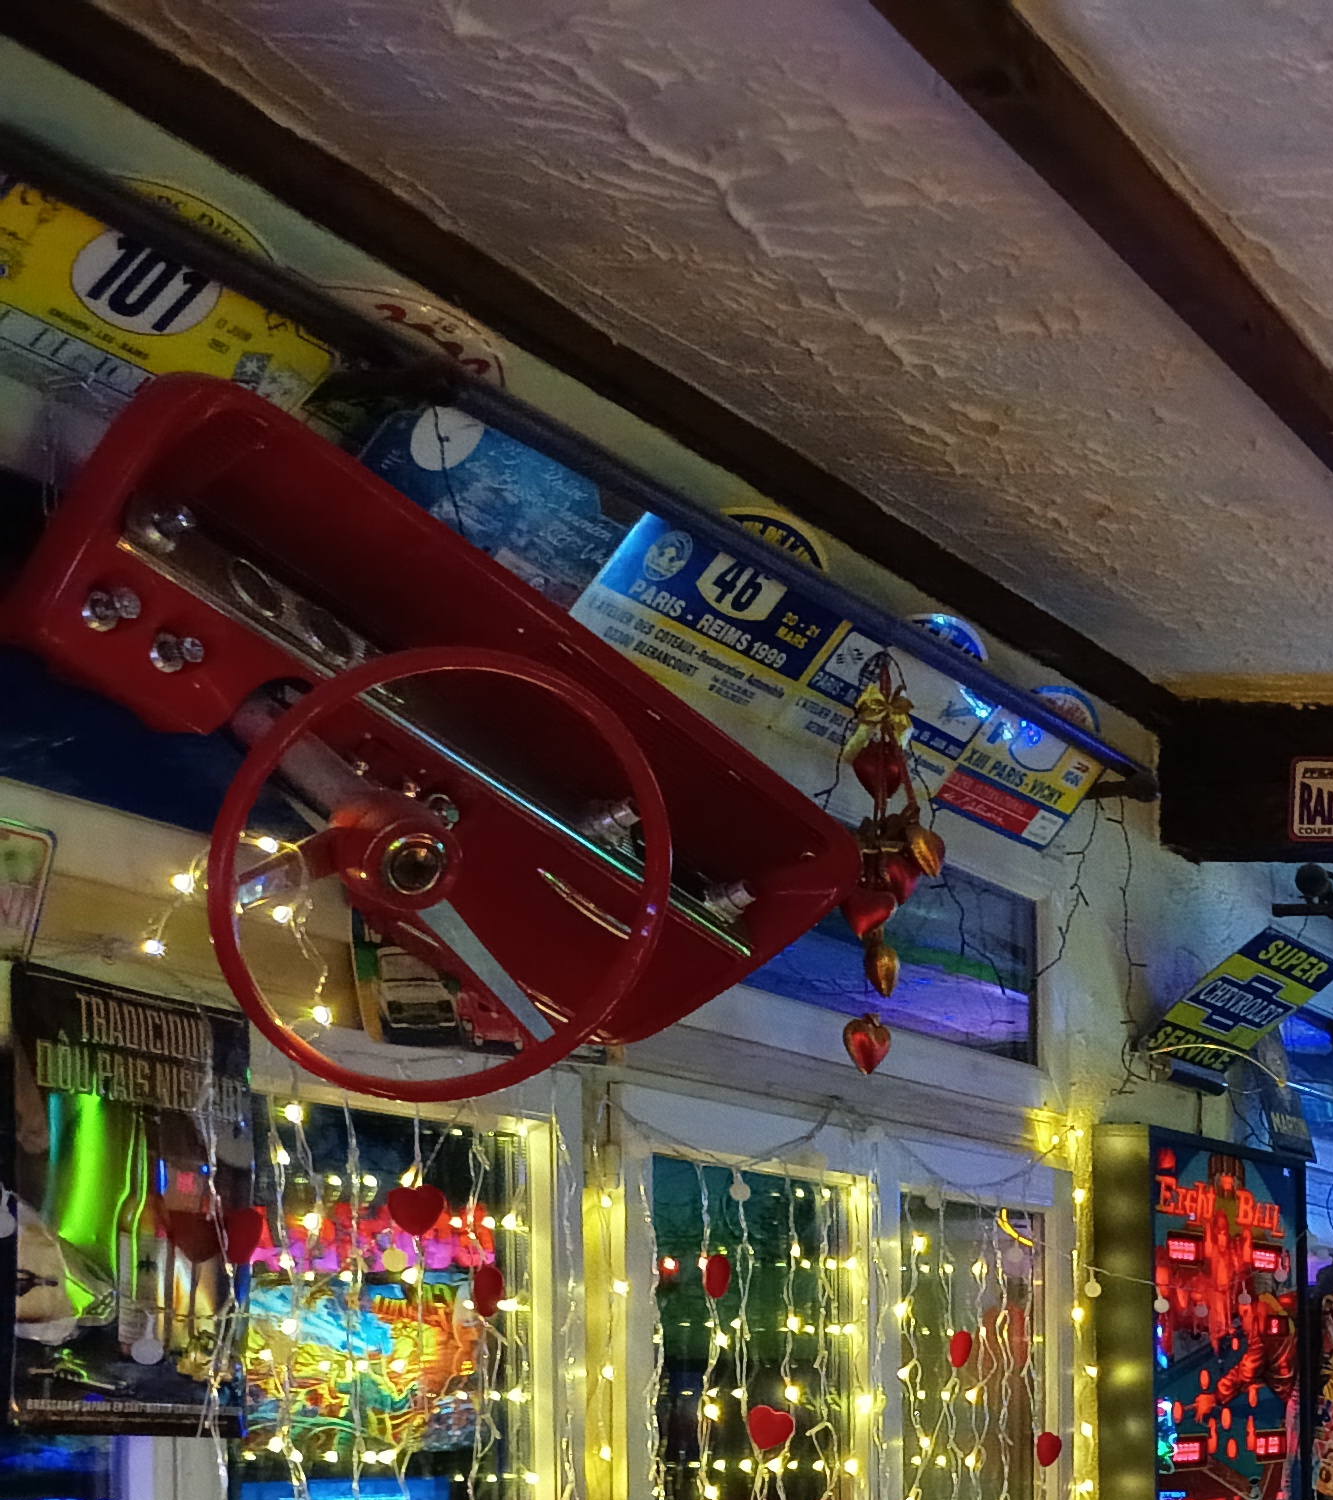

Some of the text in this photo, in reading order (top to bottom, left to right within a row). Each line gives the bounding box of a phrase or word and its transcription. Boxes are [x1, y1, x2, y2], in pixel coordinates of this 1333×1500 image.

[628, 580, 687, 618] PARIS
[696, 613, 752, 652] REIMS
[751, 641, 787, 669] 1999
[1299, 826, 1333, 836] COUPE
[1258, 939, 1329, 984] SUPER
[1199, 979, 1287, 1026] CHEVROLET
[1150, 1025, 1238, 1070] SERVICE
